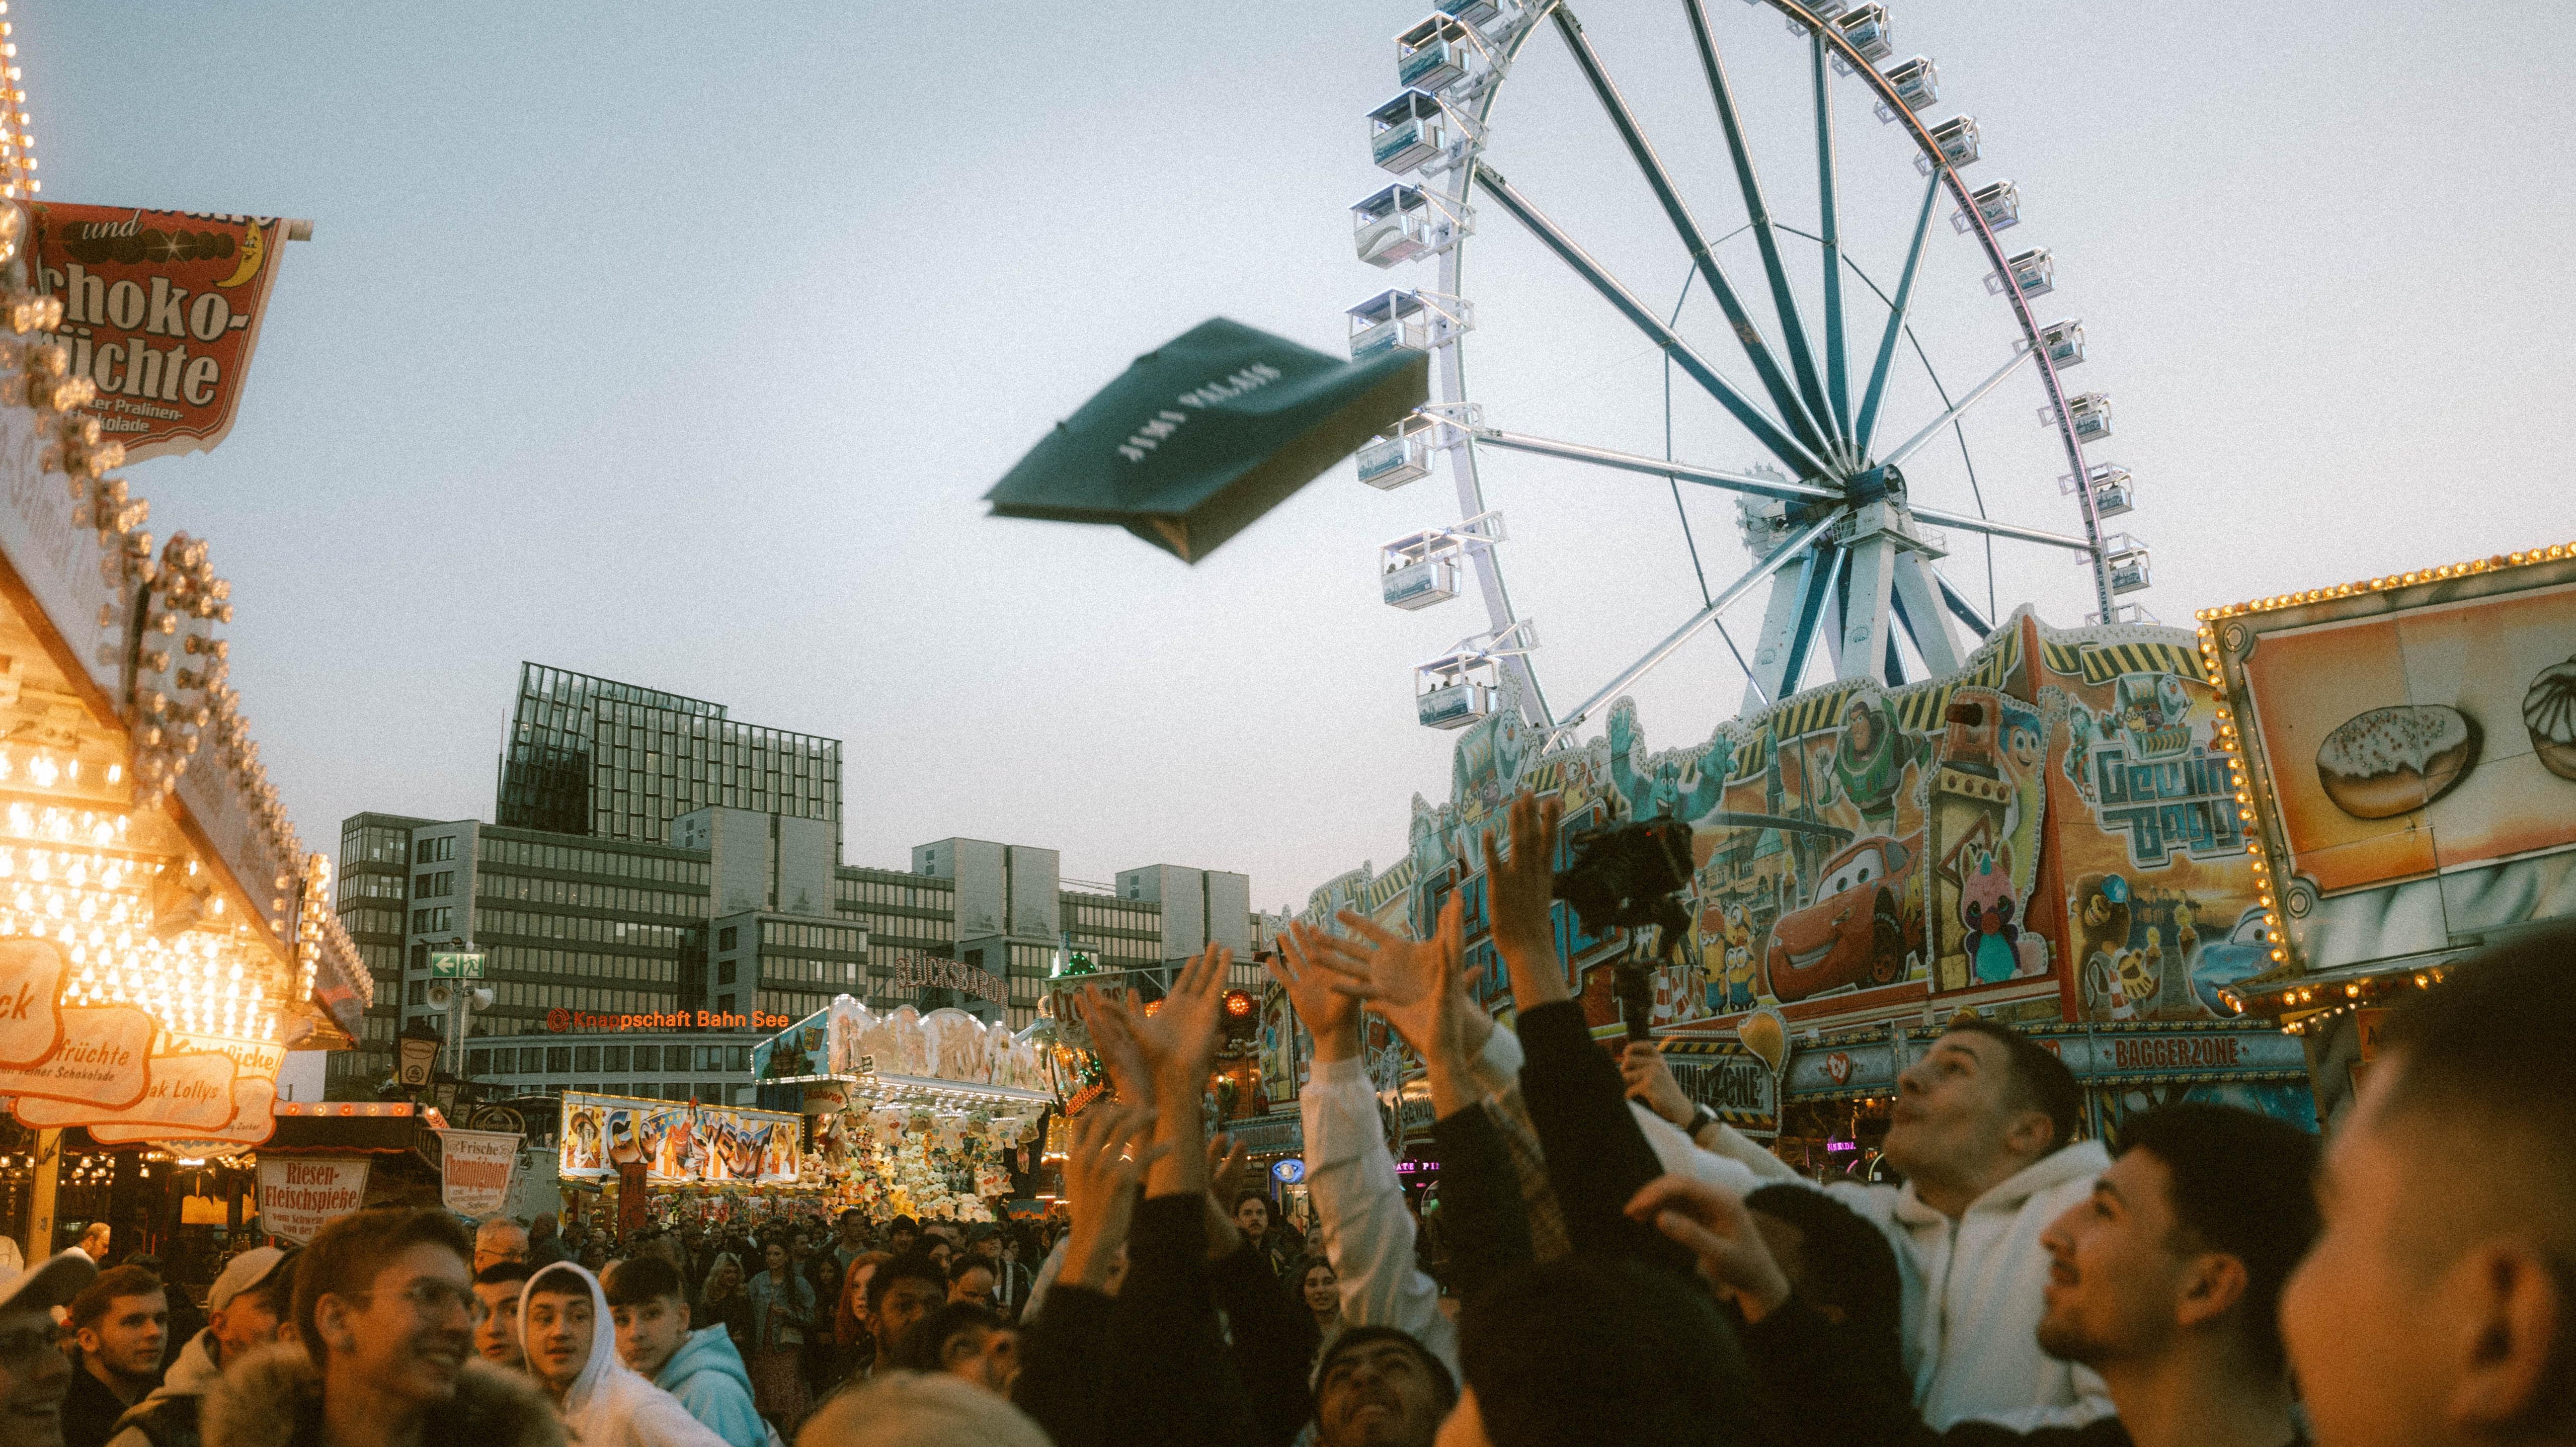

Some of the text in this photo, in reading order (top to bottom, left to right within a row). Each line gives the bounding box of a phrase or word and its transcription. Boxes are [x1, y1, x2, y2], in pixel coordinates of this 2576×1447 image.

[82, 209, 145, 239] und
[42, 325, 220, 406] üchte
[114, 398, 184, 421] Pralinen-
[2095, 747, 2236, 807] Gewin
[2102, 799, 2244, 859] Bagg
[895, 949, 1009, 1010] GLÜCKSBARON
[574, 1010, 789, 1031] Knappschaft Bahn See
[2115, 1036, 2239, 1068] BAGGERZONE
[55, 1066, 115, 1082] Schokolade
[1828, 1054, 1846, 1079] ty
[173, 1080, 219, 1104] Lollys
[460, 1140, 499, 1155] Frische
[286, 1162, 340, 1185] Riesen-
[1393, 1163, 1414, 1171] ATE
[265, 1185, 357, 1213] Fleischspieße
